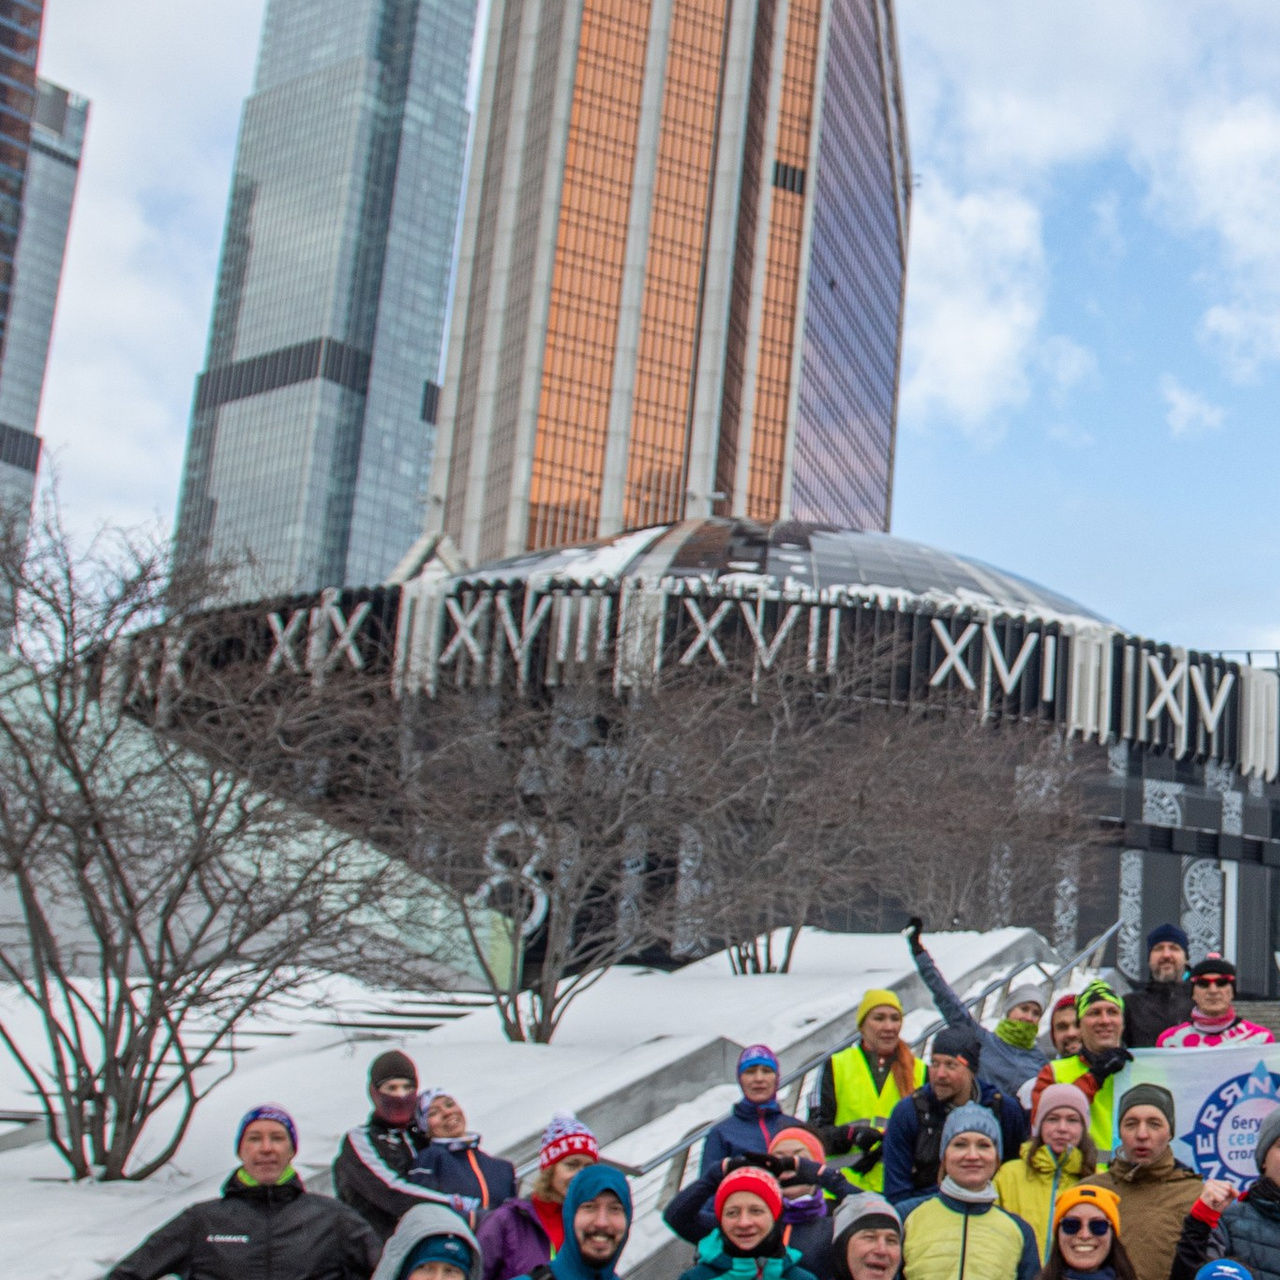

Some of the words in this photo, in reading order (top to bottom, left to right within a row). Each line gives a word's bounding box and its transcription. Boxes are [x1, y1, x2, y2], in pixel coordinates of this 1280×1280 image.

[438, 594, 612, 663] XVIII
[678, 597, 841, 674] XVII
[929, 618, 1055, 702] XVI
[1146, 654, 1235, 733] XV
[1231, 1115, 1262, 1133] бегу
[1228, 1134, 1257, 1146] сев
